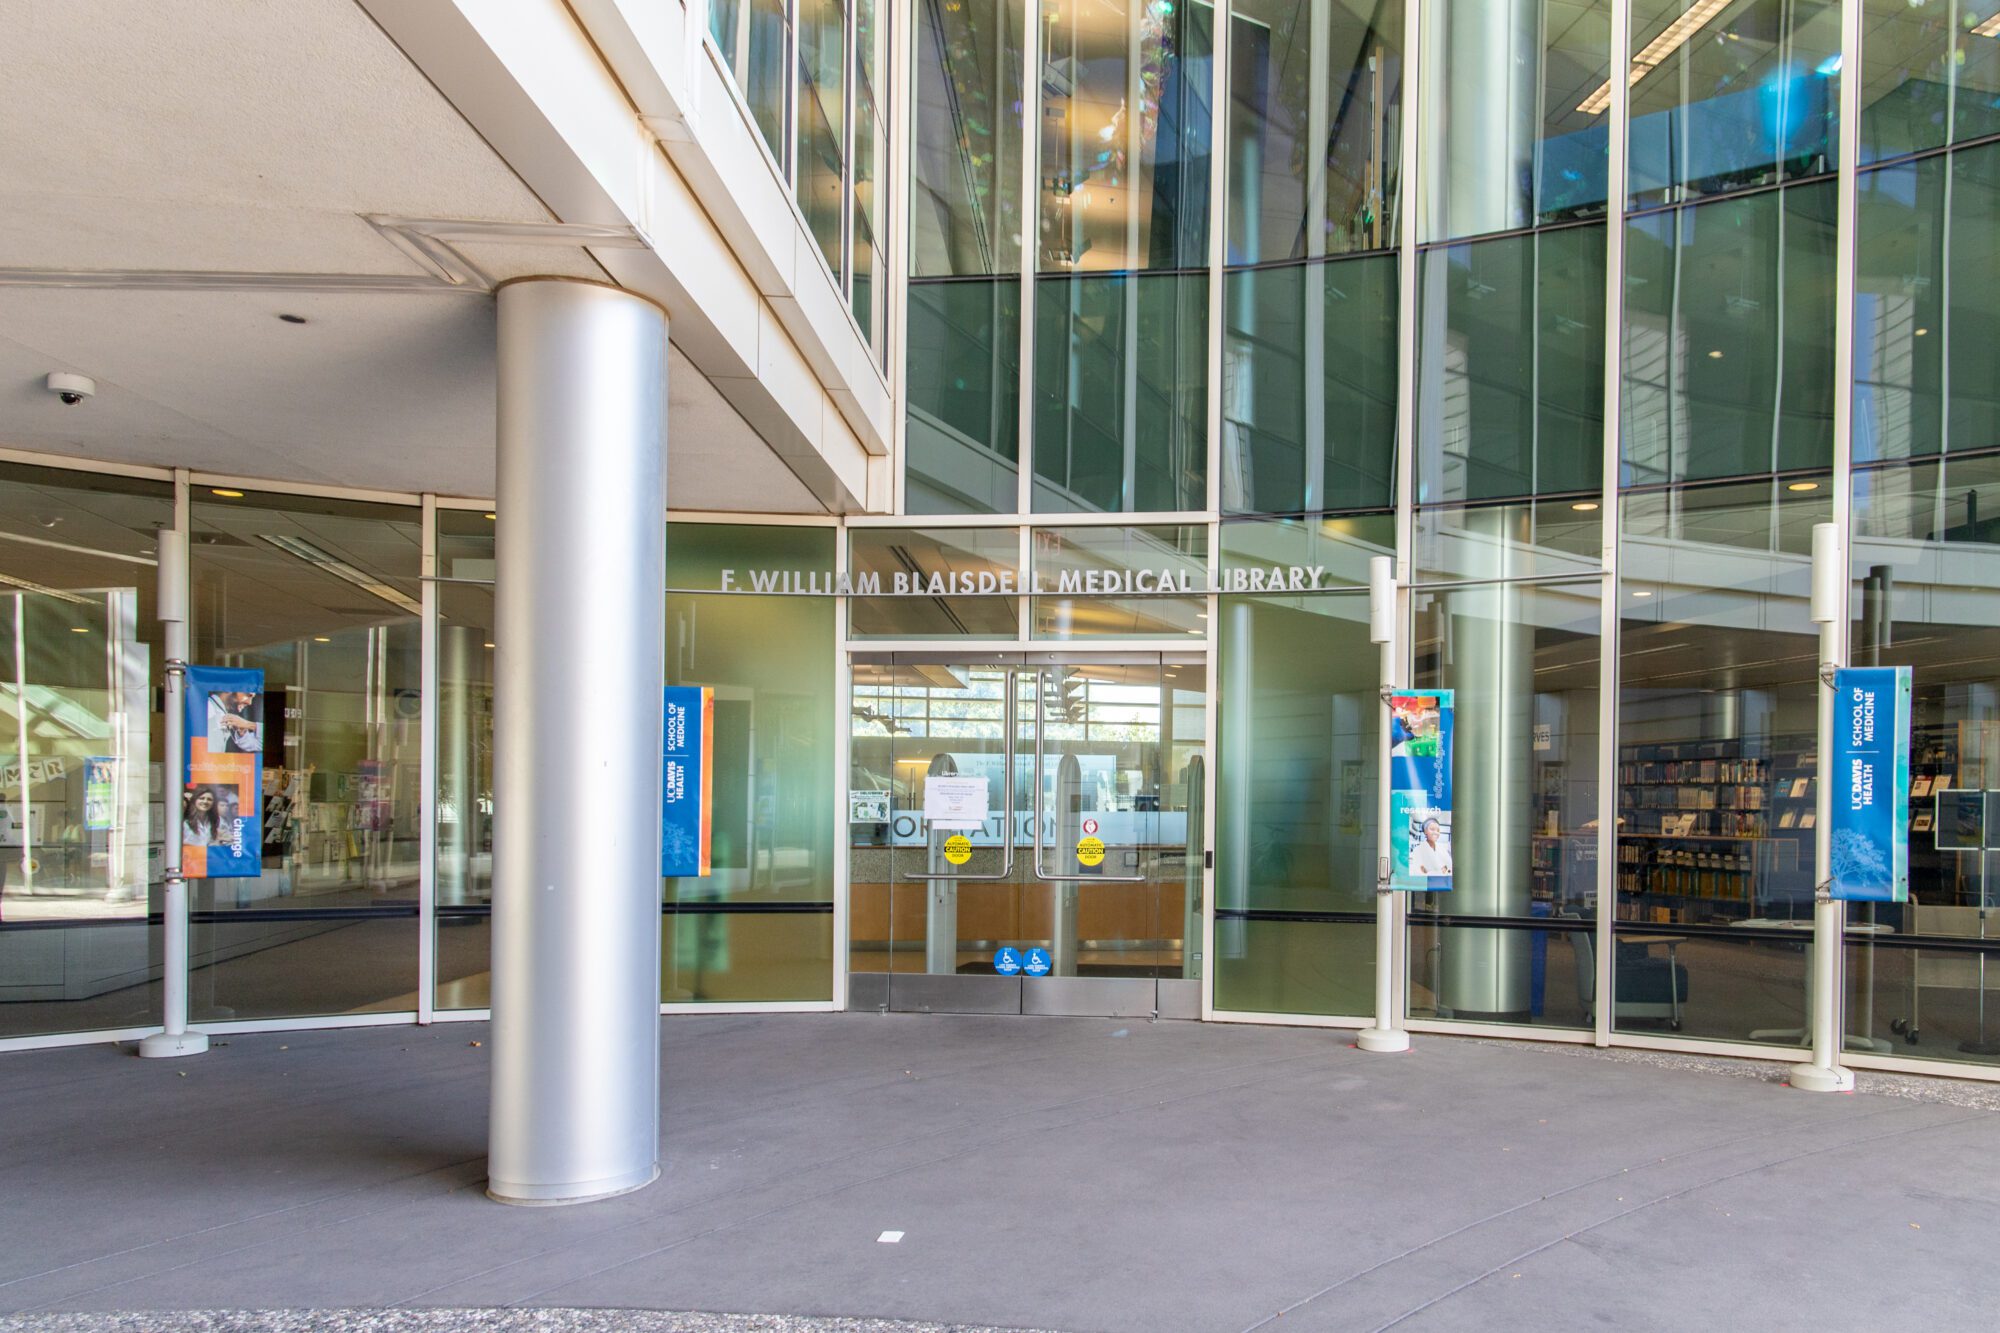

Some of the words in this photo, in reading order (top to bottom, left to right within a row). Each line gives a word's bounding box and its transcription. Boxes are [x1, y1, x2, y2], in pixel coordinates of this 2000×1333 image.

[721, 569, 742, 593] F.
[749, 570, 881, 594] WILLIAM
[893, 570, 1044, 594] BLAISDELL
[1058, 568, 1191, 593] MEDICAL
[1208, 566, 1324, 592] LIBRARY
[668, 702, 677, 714] OF
[1853, 687, 1863, 701] OF
[677, 706, 686, 747] MEDICINE
[1852, 703, 1863, 746] SCHOOL
[1864, 691, 1875, 742] MEDICINE
[668, 717, 677, 751] SCHOOL
[675, 765, 685, 799] HEALTH
[1863, 764, 1873, 805] HEALTH
[1400, 805, 1442, 815] research
[231, 818, 245, 858] change
